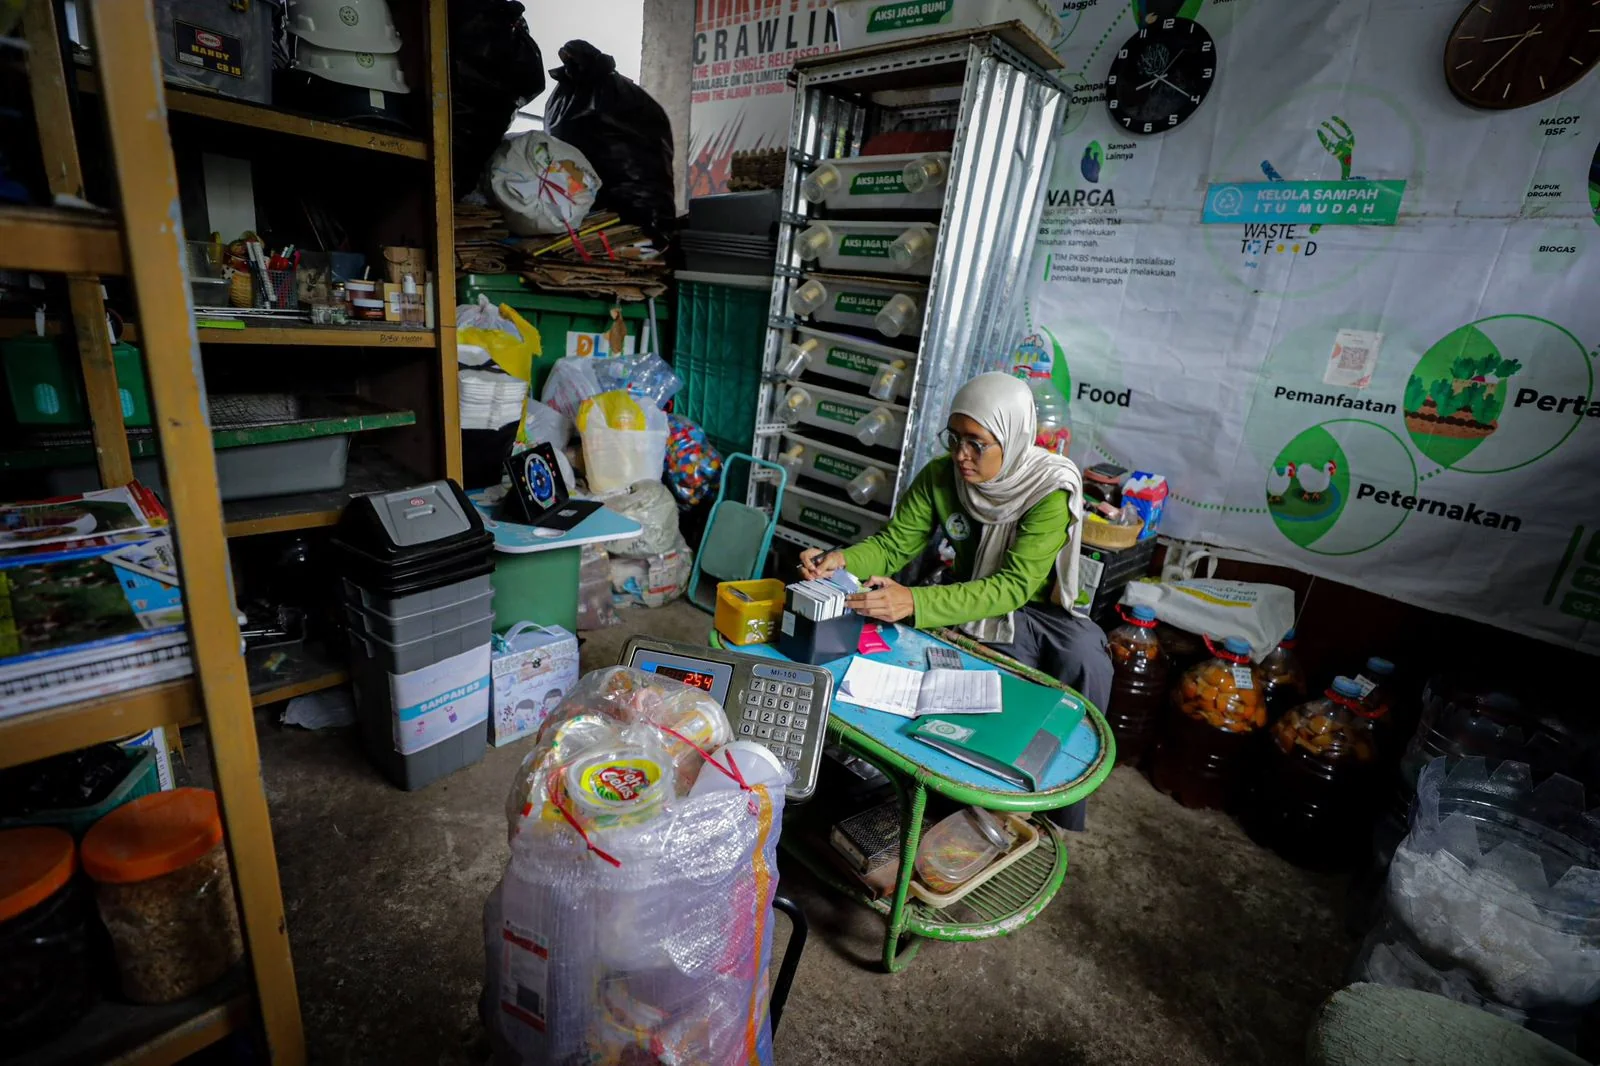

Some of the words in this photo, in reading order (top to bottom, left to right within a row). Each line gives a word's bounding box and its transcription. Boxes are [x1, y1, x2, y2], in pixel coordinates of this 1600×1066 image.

[875, 9, 896, 21] AKSI
[897, 5, 920, 18] JAGA
[921, 1, 946, 14] BUMI
[1063, 0, 1097, 11] Maggot
[1163, 18, 1175, 29] 12
[1189, 24, 1195, 33] 1
[1139, 29, 1148, 38] 11
[1202, 41, 1212, 52] 2
[191, 45, 230, 61] HANDY
[1118, 49, 1129, 59] 10
[712, 61, 732, 76] NEW
[734, 56, 765, 73] SINGLE
[1202, 68, 1213, 78] 3
[1108, 75, 1117, 85] 9
[1109, 99, 1119, 109] 8
[1190, 95, 1201, 105] 4
[1122, 118, 1132, 127] 7
[1168, 114, 1179, 125] 5
[1539, 116, 1580, 126] MAGOT
[1143, 122, 1153, 132] 6
[1545, 127, 1566, 136] BSF
[1107, 142, 1137, 151] Sampah
[1105, 152, 1135, 161] Lainnya
[856, 175, 874, 186] AKSI
[875, 174, 894, 185] JAGA
[1257, 189, 1310, 200] KELOLA
[1313, 188, 1379, 200] SAMPAH
[1253, 203, 1287, 214] ITU
[1298, 203, 1375, 214] MUDAH
[1107, 218, 1122, 226] TIM
[1244, 223, 1296, 239] WASTE
[845, 239, 861, 248] AKSI
[862, 239, 881, 249] JAGA
[1539, 245, 1576, 253] BIOGAS
[1091, 255, 1134, 264] melakukan
[1080, 266, 1103, 275] warga
[1105, 267, 1128, 275] untuk
[1130, 268, 1176, 277] melakukan
[1092, 277, 1123, 285] sampah
[841, 295, 857, 304] AKSI
[858, 297, 876, 306] JAGA
[831, 349, 847, 360] AKSI
[847, 352, 865, 364] JAGA
[1077, 382, 1132, 408] Food
[1274, 386, 1397, 415] Pemanfaatan
[820, 402, 836, 413] AKSI
[836, 405, 853, 417] JAGA
[818, 456, 833, 466] AKSI
[1356, 483, 1522, 532] Peternakan
[804, 509, 819, 520] AKSI
[820, 513, 837, 526] JAGA
[770, 669, 797, 679] MI-150
[769, 684, 776, 692] 8
[420, 688, 466, 712] SAMPAH
[766, 698, 773, 706] 5
[783, 701, 789, 709] 6
[763, 713, 770, 721] 2
[780, 716, 786, 724] 3
[795, 720, 804, 728] M2
[743, 725, 750, 733] 0
[792, 734, 801, 742] M3
[601, 771, 634, 799] Gelas
